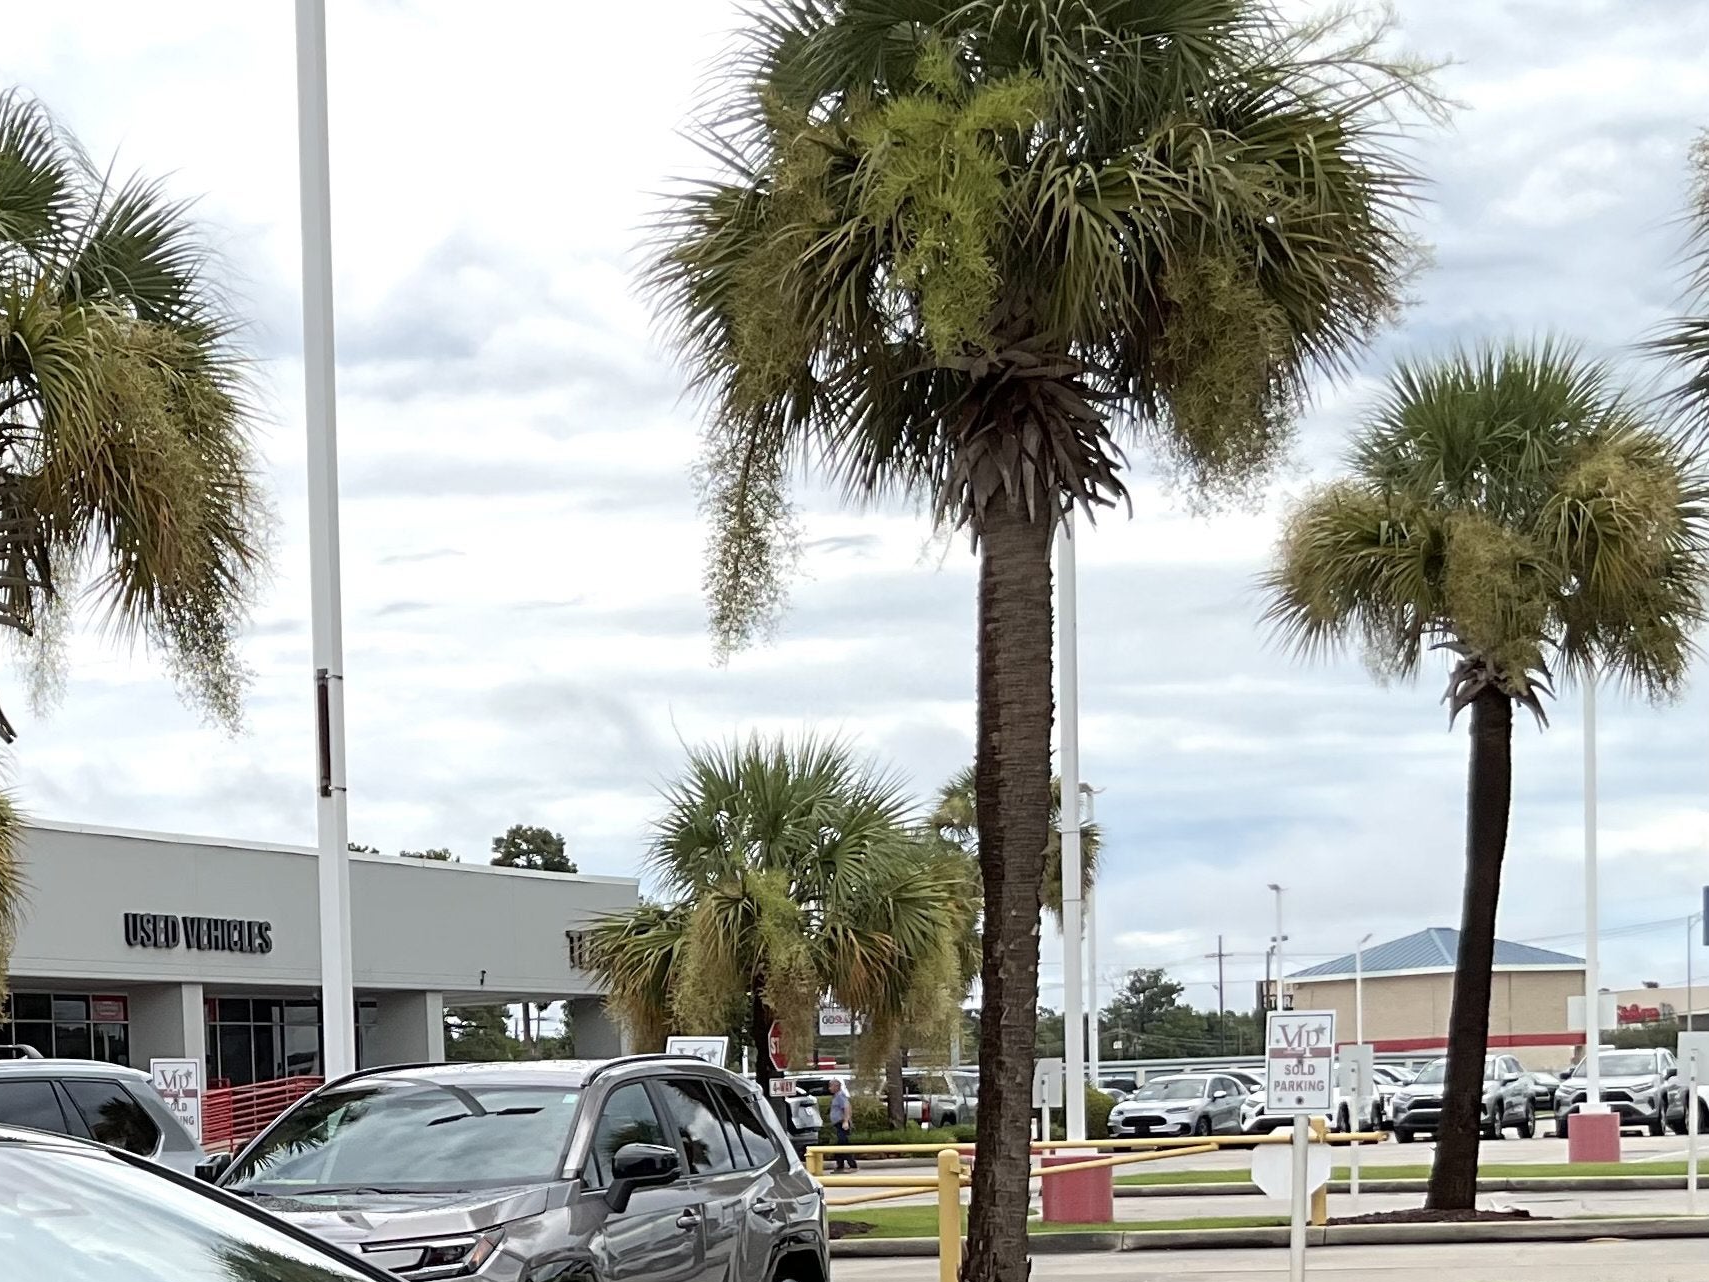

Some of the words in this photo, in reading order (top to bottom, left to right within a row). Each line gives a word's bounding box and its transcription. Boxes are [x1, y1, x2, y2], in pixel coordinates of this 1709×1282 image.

[124, 912, 180, 948] USED
[181, 916, 272, 953] VEHICLES
[1284, 1064, 1316, 1075] SOLD
[1274, 1080, 1325, 1092] PARKING
[165, 1102, 188, 1112] OLD
